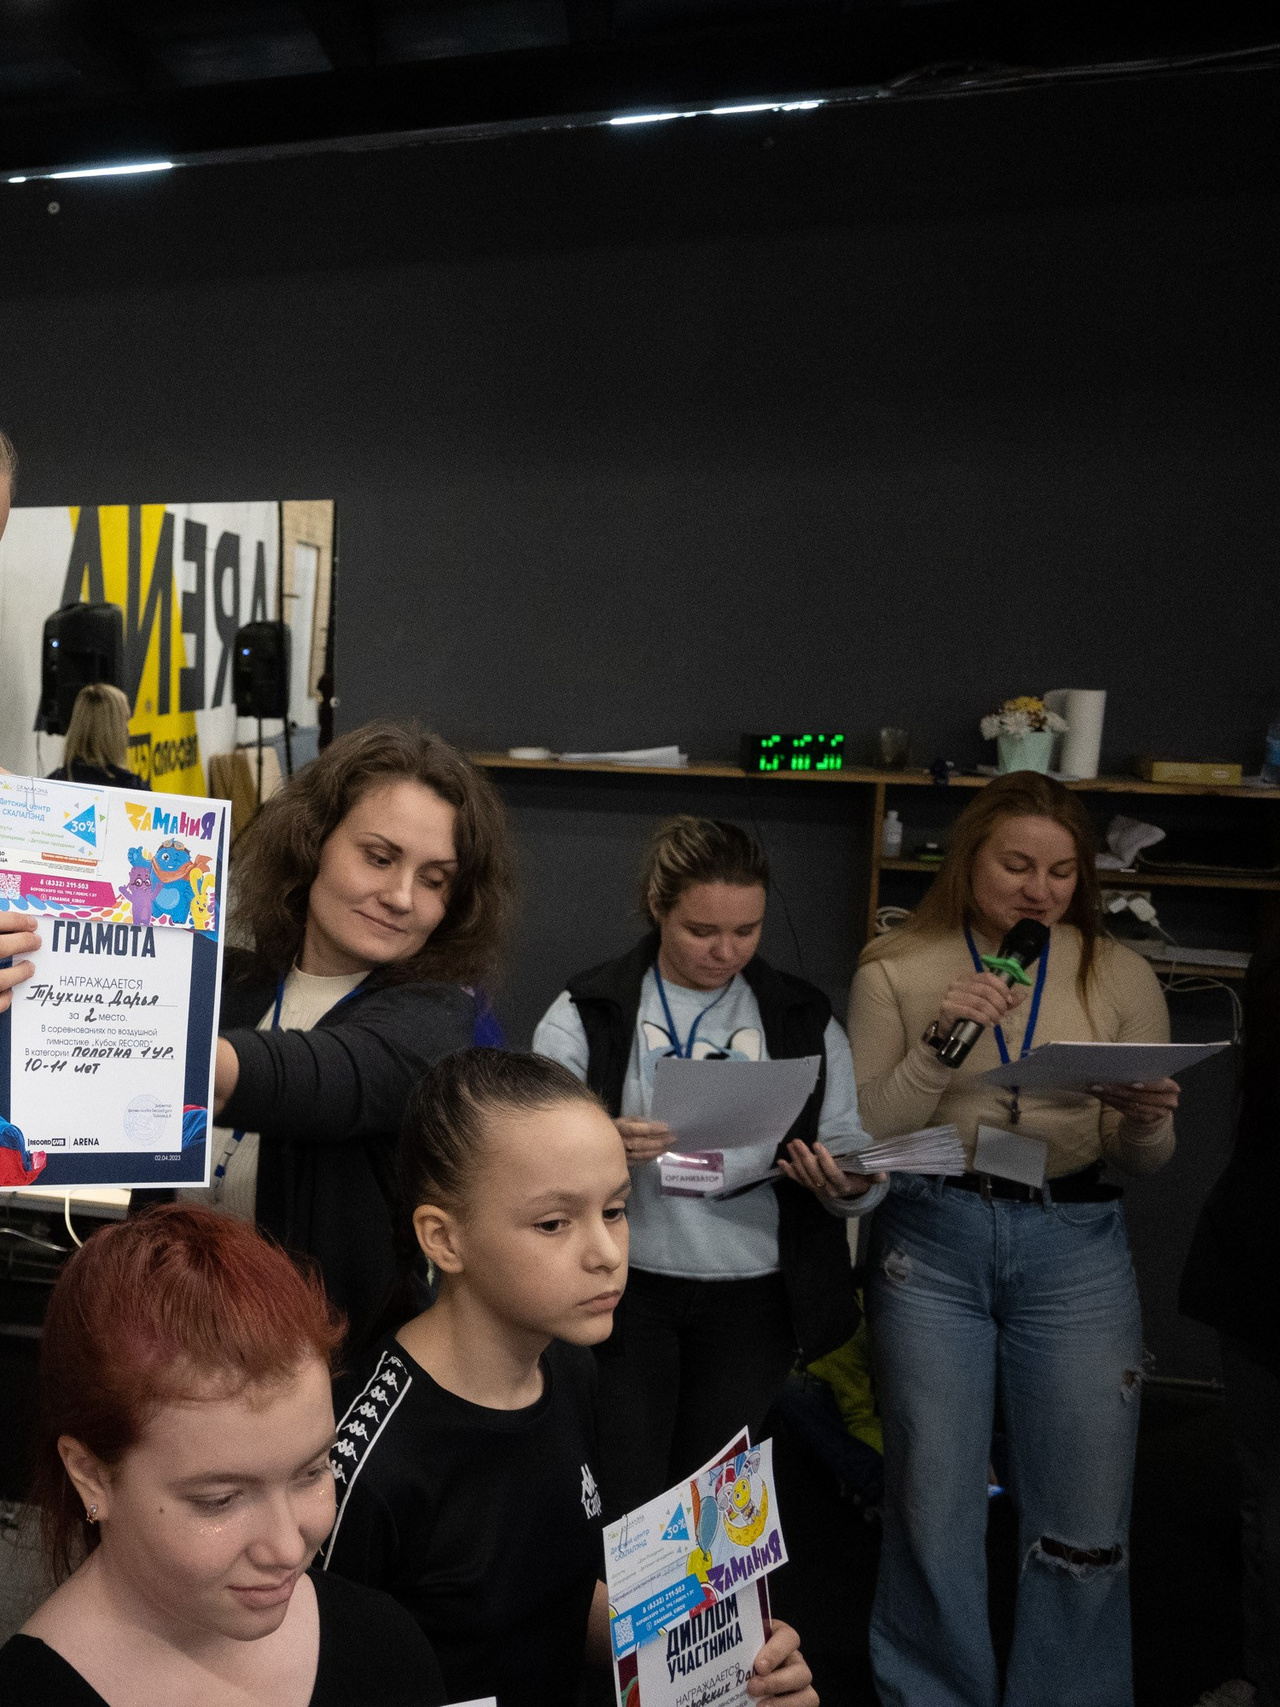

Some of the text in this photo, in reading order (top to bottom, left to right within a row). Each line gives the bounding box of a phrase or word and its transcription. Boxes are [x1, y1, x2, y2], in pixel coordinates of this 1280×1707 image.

[2, 809, 45, 822] СКАЛАЛЭНД
[70, 820, 96, 833] 30%
[52, 920, 156, 958] ГРАМОТА
[59, 976, 143, 990] НАГРАЖДАЕТСЯ
[26, 984, 159, 1008] Трухина Дарья
[69, 1007, 127, 1022] за 2 место.
[48, 1026, 106, 1034] соревнованиях
[118, 1028, 158, 1037] воздушной
[46, 1038, 89, 1046] гимнастике
[25, 1048, 30, 1056] В
[31, 1049, 69, 1057] категории
[24, 1058, 101, 1075] 10-11 лет
[73, 1138, 100, 1146] ARENA
[667, 1518, 687, 1539] 30%
[666, 1592, 739, 1661] ДИПЛОМ
[667, 1621, 743, 1683] УЧАСТНИКА
[675, 1663, 740, 1706] НАГРАЖДАЕТСЯ
